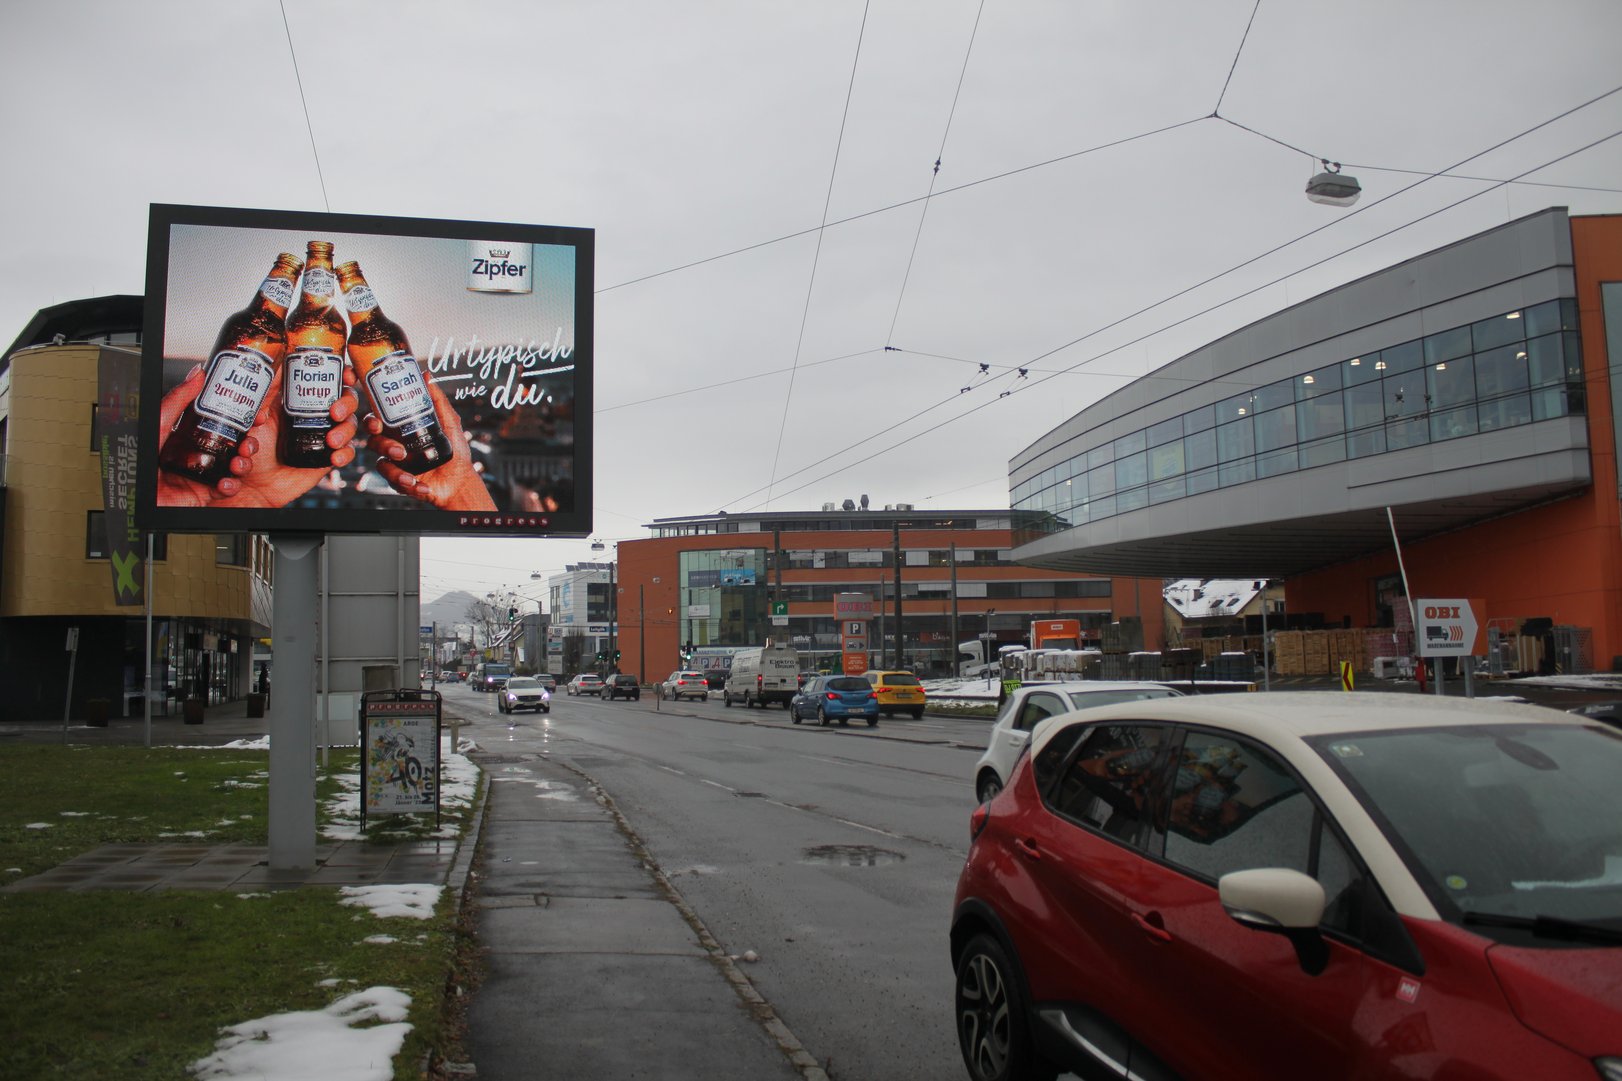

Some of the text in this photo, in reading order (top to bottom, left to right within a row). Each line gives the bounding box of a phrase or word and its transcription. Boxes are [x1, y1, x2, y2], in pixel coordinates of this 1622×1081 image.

[472, 258, 526, 280] Zipfer
[427, 327, 573, 380] Urtypisch
[224, 369, 259, 392] Julia
[293, 369, 335, 382] Florian
[381, 372, 418, 394] Sarah
[454, 363, 553, 410] wie du.
[295, 384, 331, 399] Urtyp
[460, 517, 548, 526] progress
[1424, 606, 1461, 619] OBI
[852, 623, 859, 634] P
[421, 766, 435, 805] Motz
